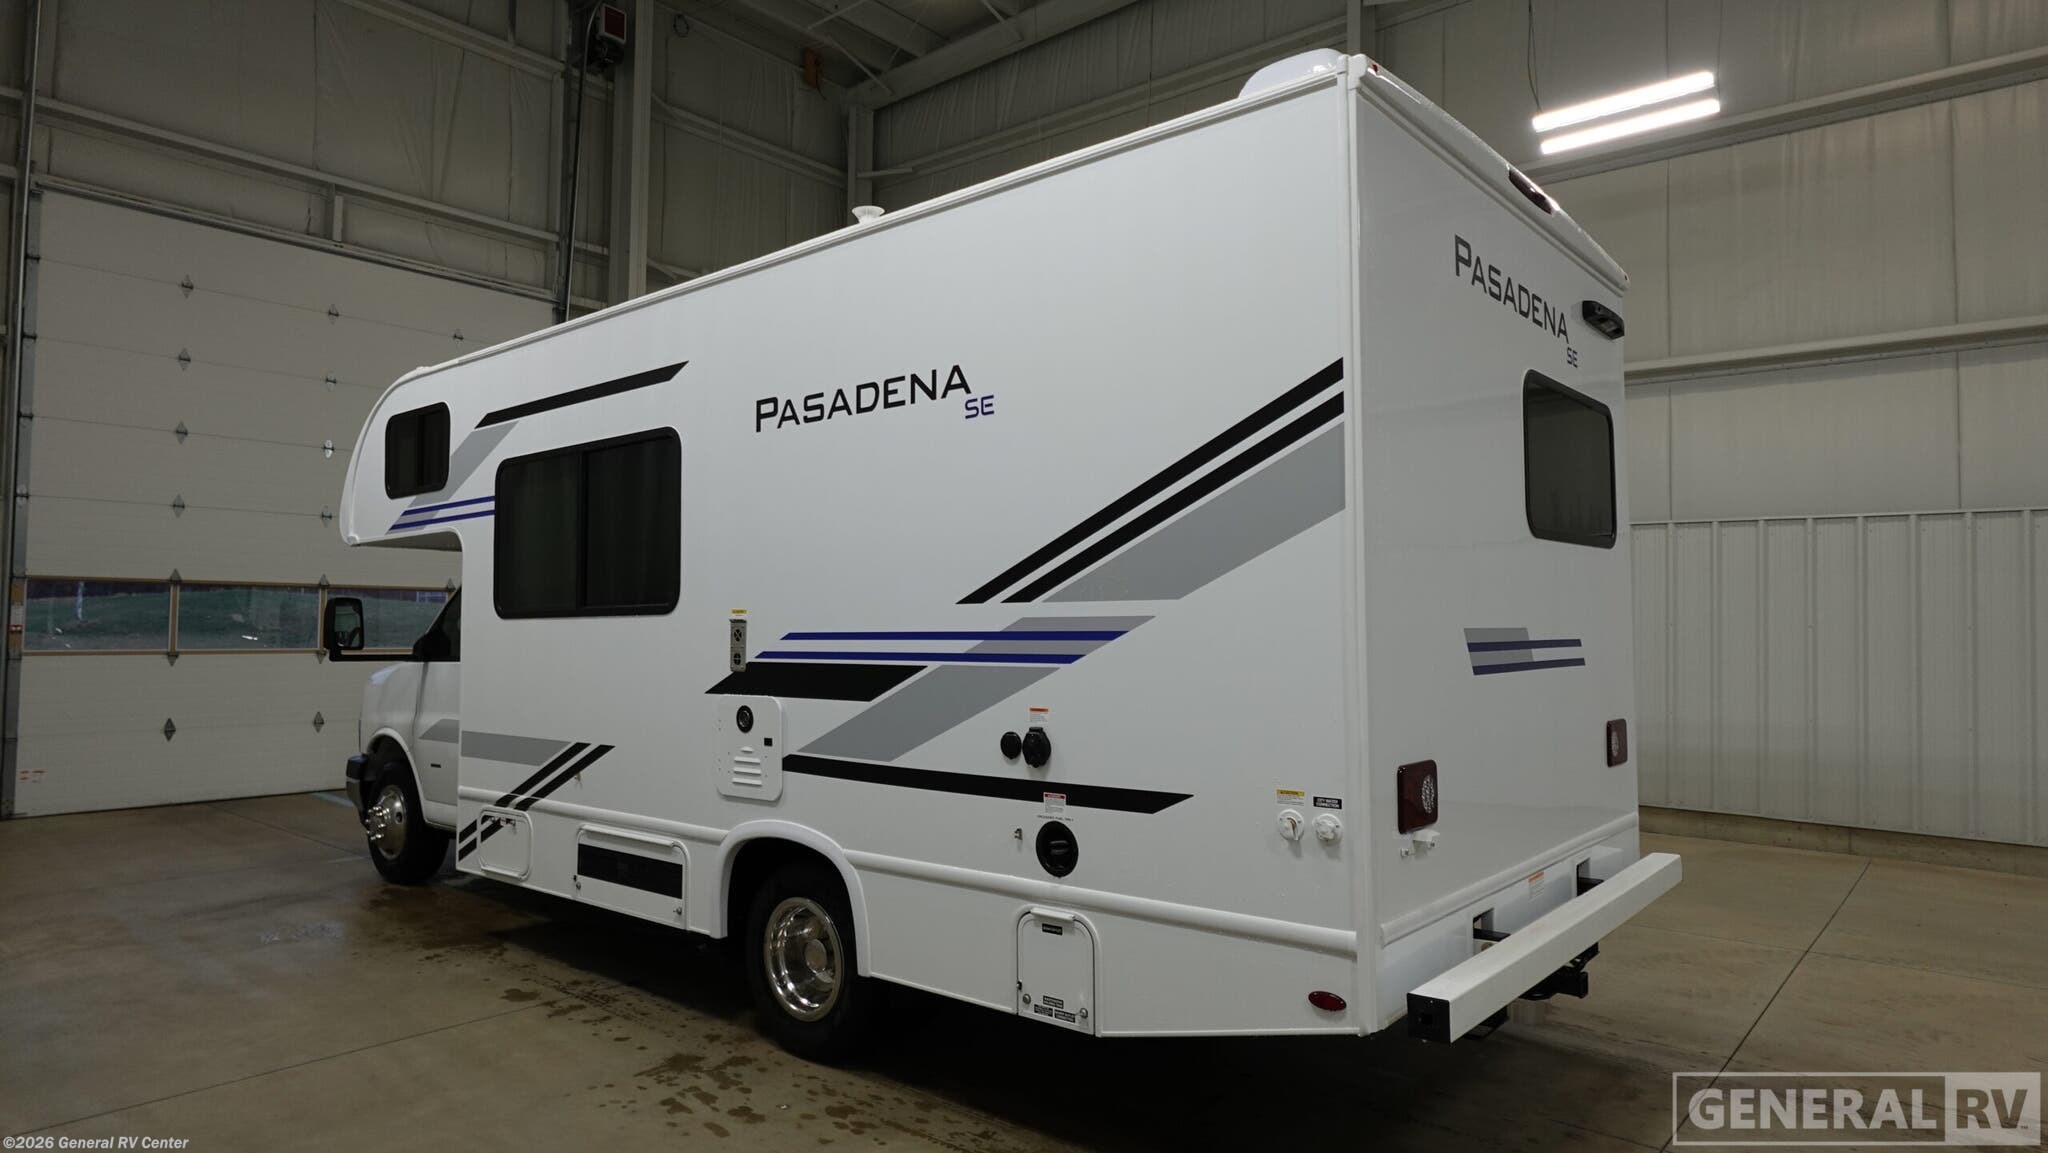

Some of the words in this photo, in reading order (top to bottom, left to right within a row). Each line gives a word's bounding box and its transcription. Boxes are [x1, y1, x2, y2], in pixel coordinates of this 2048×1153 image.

[1455, 234, 1569, 345] PASADENA
[1566, 346, 1578, 369] SE
[756, 364, 972, 433] PASADENA
[964, 394, 995, 419] SE
